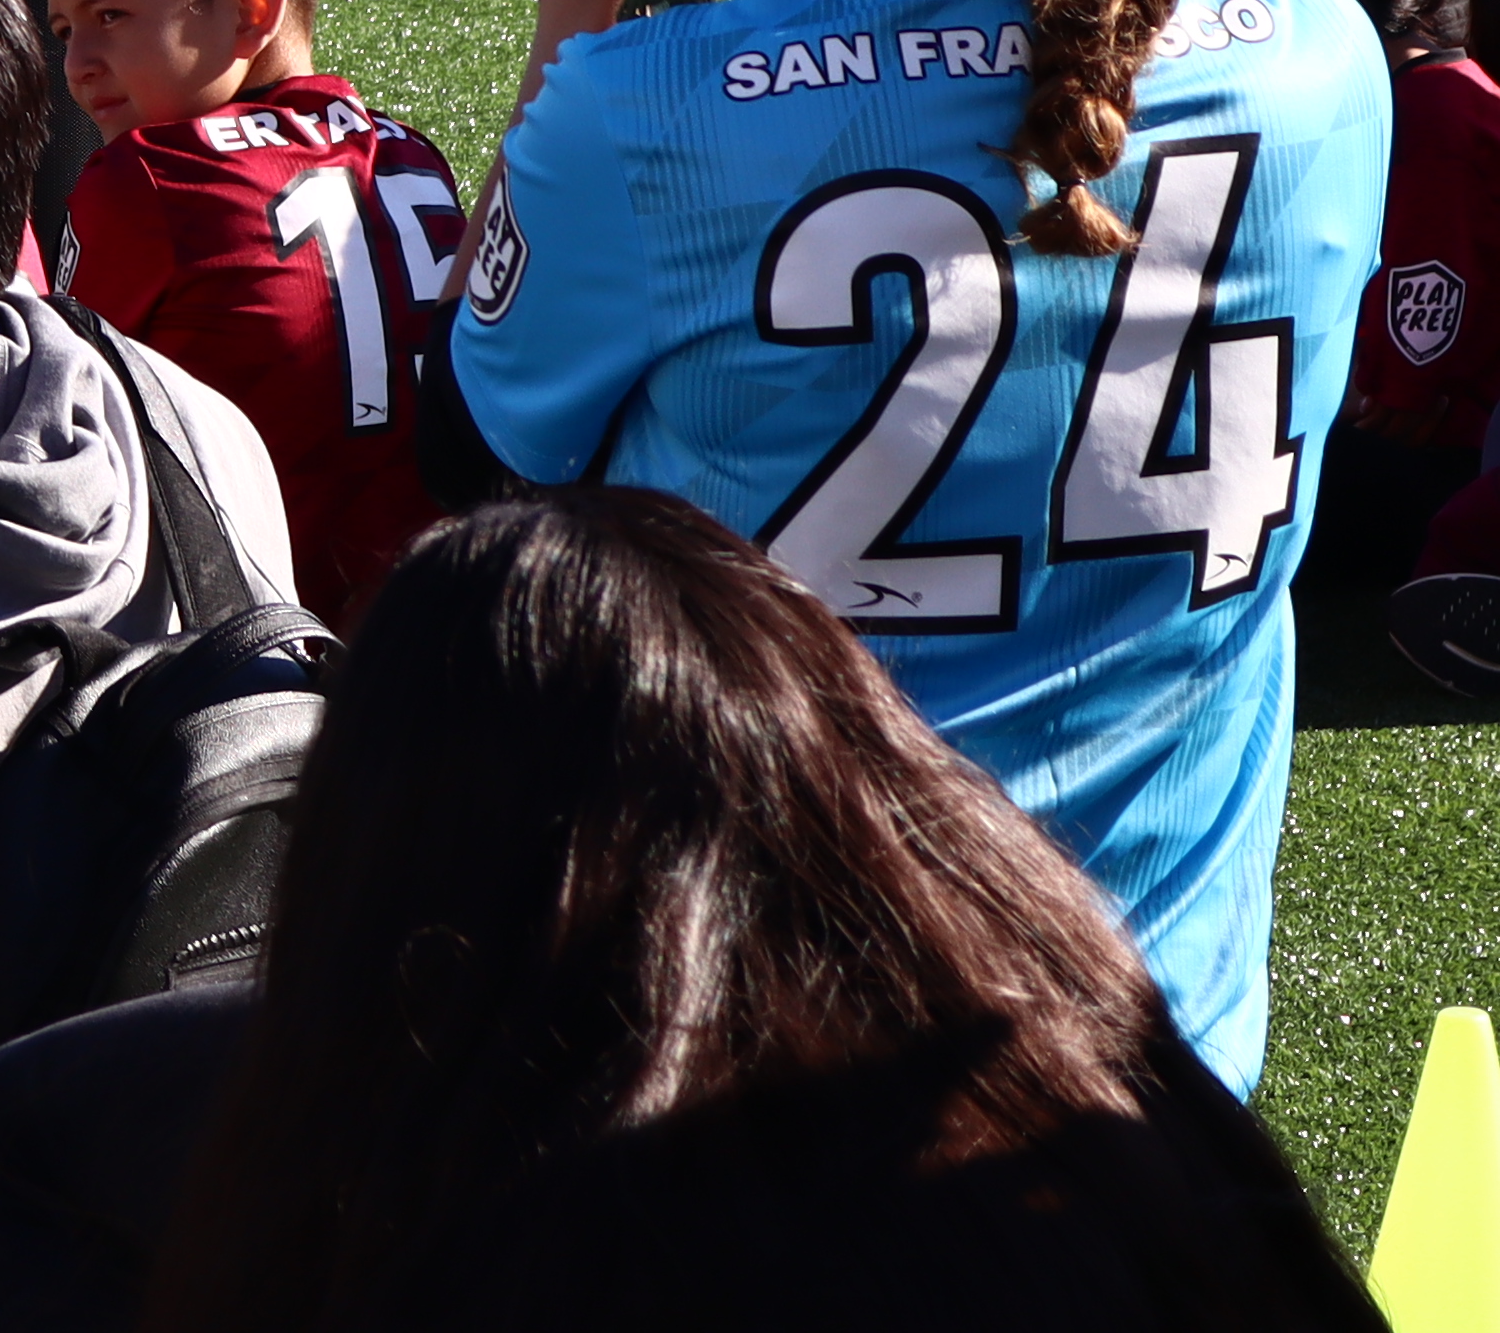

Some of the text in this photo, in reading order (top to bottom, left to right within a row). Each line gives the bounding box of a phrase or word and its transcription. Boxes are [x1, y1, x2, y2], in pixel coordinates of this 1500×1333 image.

[723, 33, 880, 101] SAN
[201, 112, 291, 152] ER
[1397, 280, 1458, 307] PLAY
[1398, 307, 1456, 332] FREE
[754, 133, 1306, 636] 24
